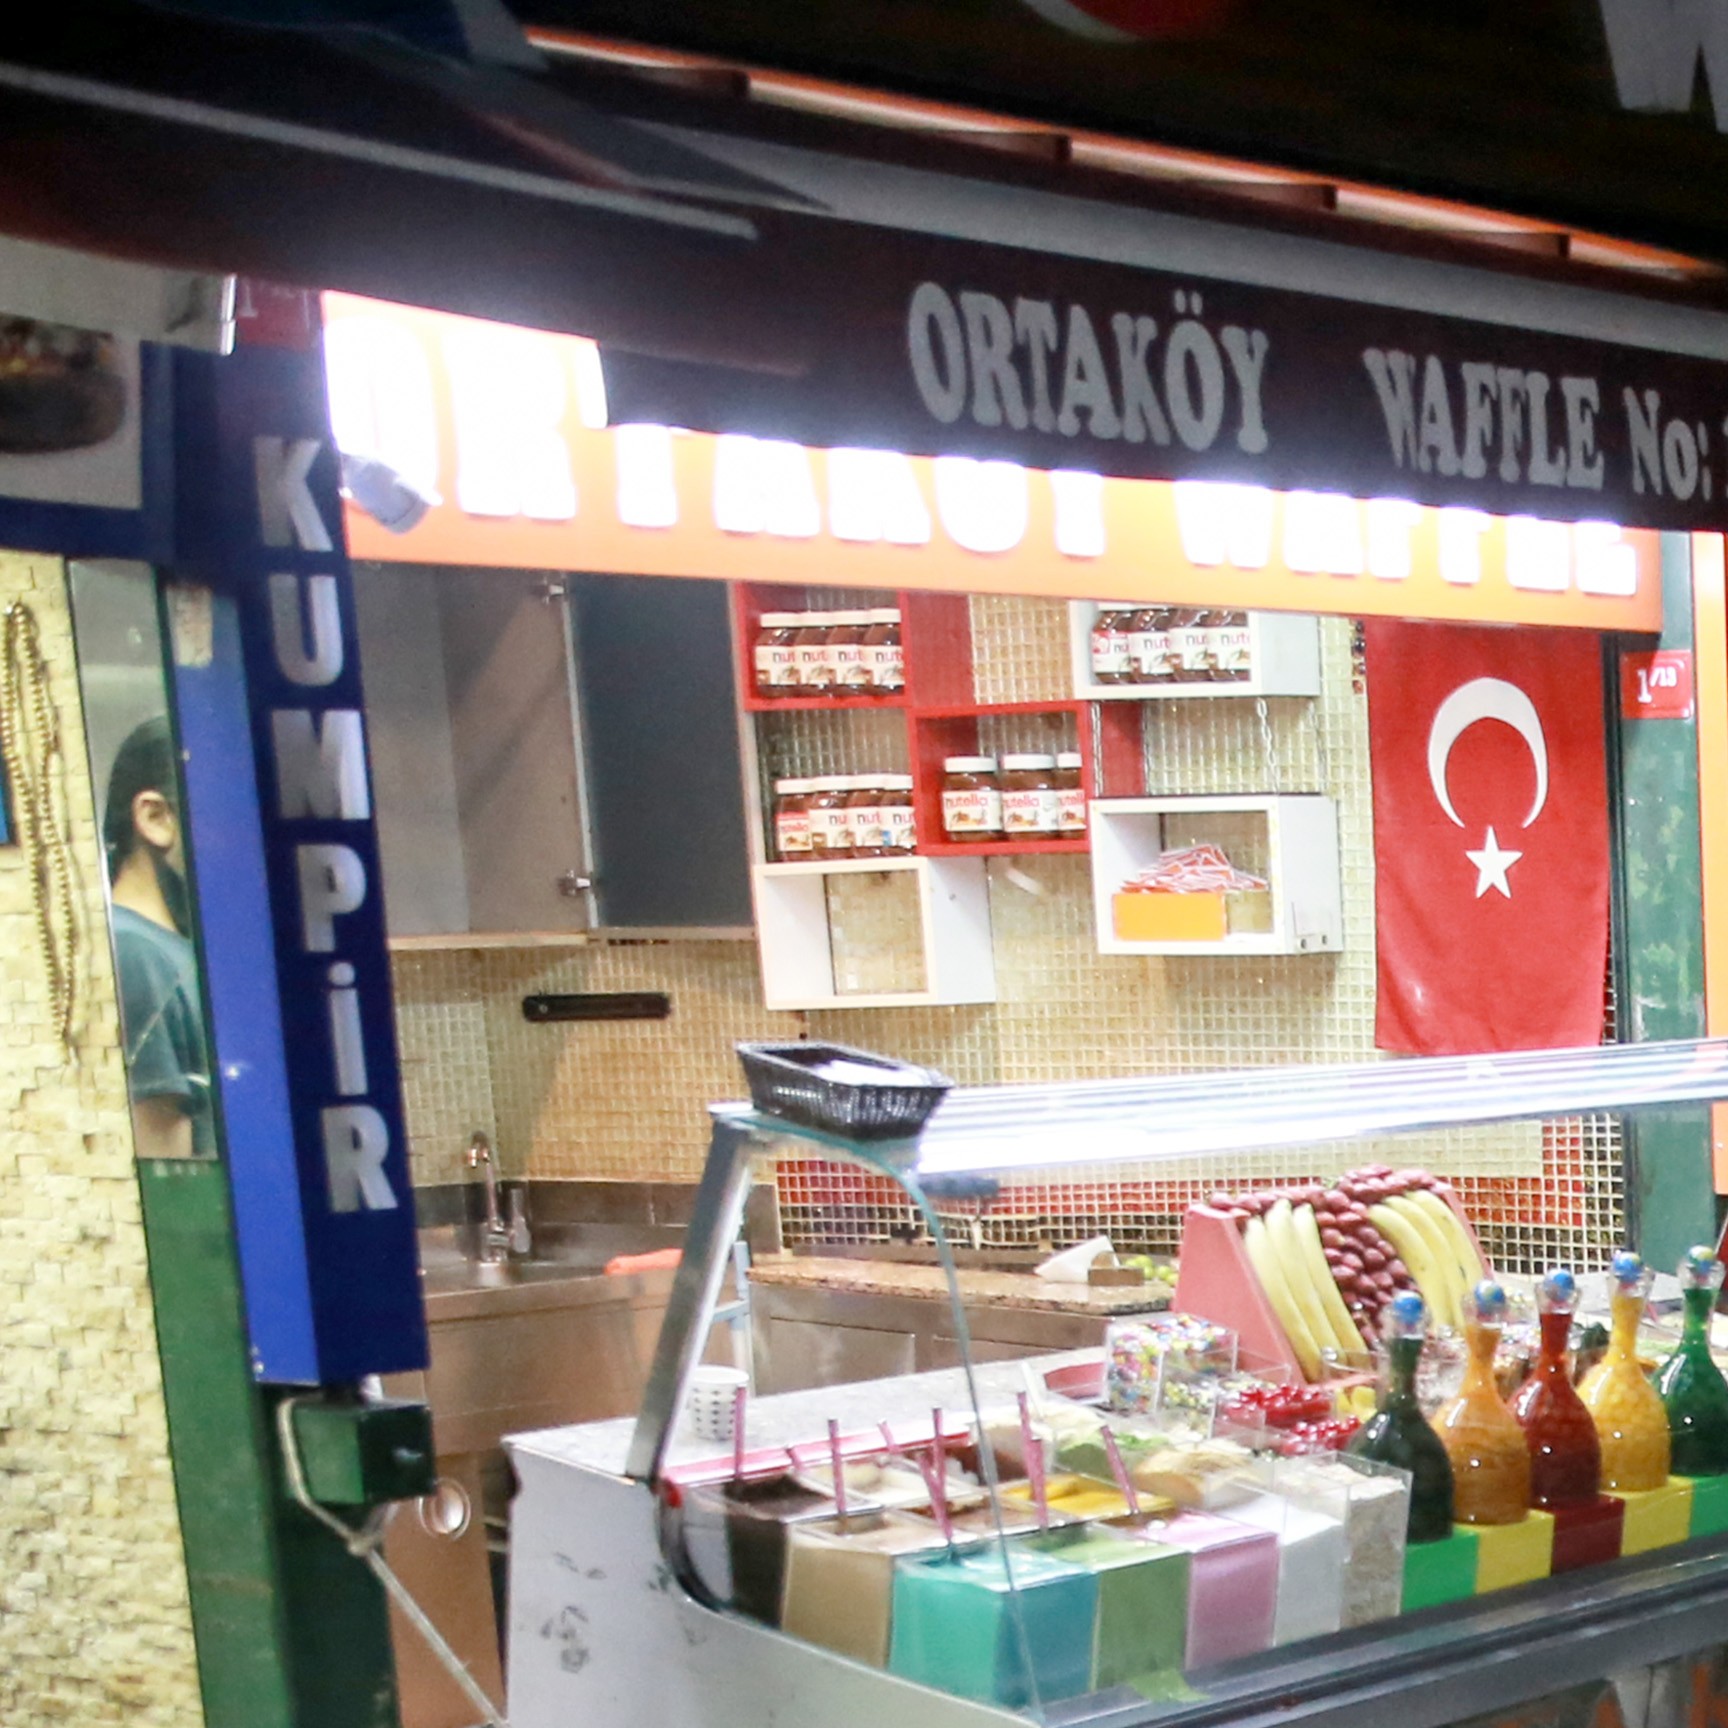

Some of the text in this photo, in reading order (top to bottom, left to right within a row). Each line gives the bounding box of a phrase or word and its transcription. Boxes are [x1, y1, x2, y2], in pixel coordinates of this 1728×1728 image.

[908, 281, 1270, 455] ORTAKÖY
[1362, 347, 1605, 490] WAFFLE
[1623, 386, 1713, 501] No:
[945, 793, 989, 809] nutella
